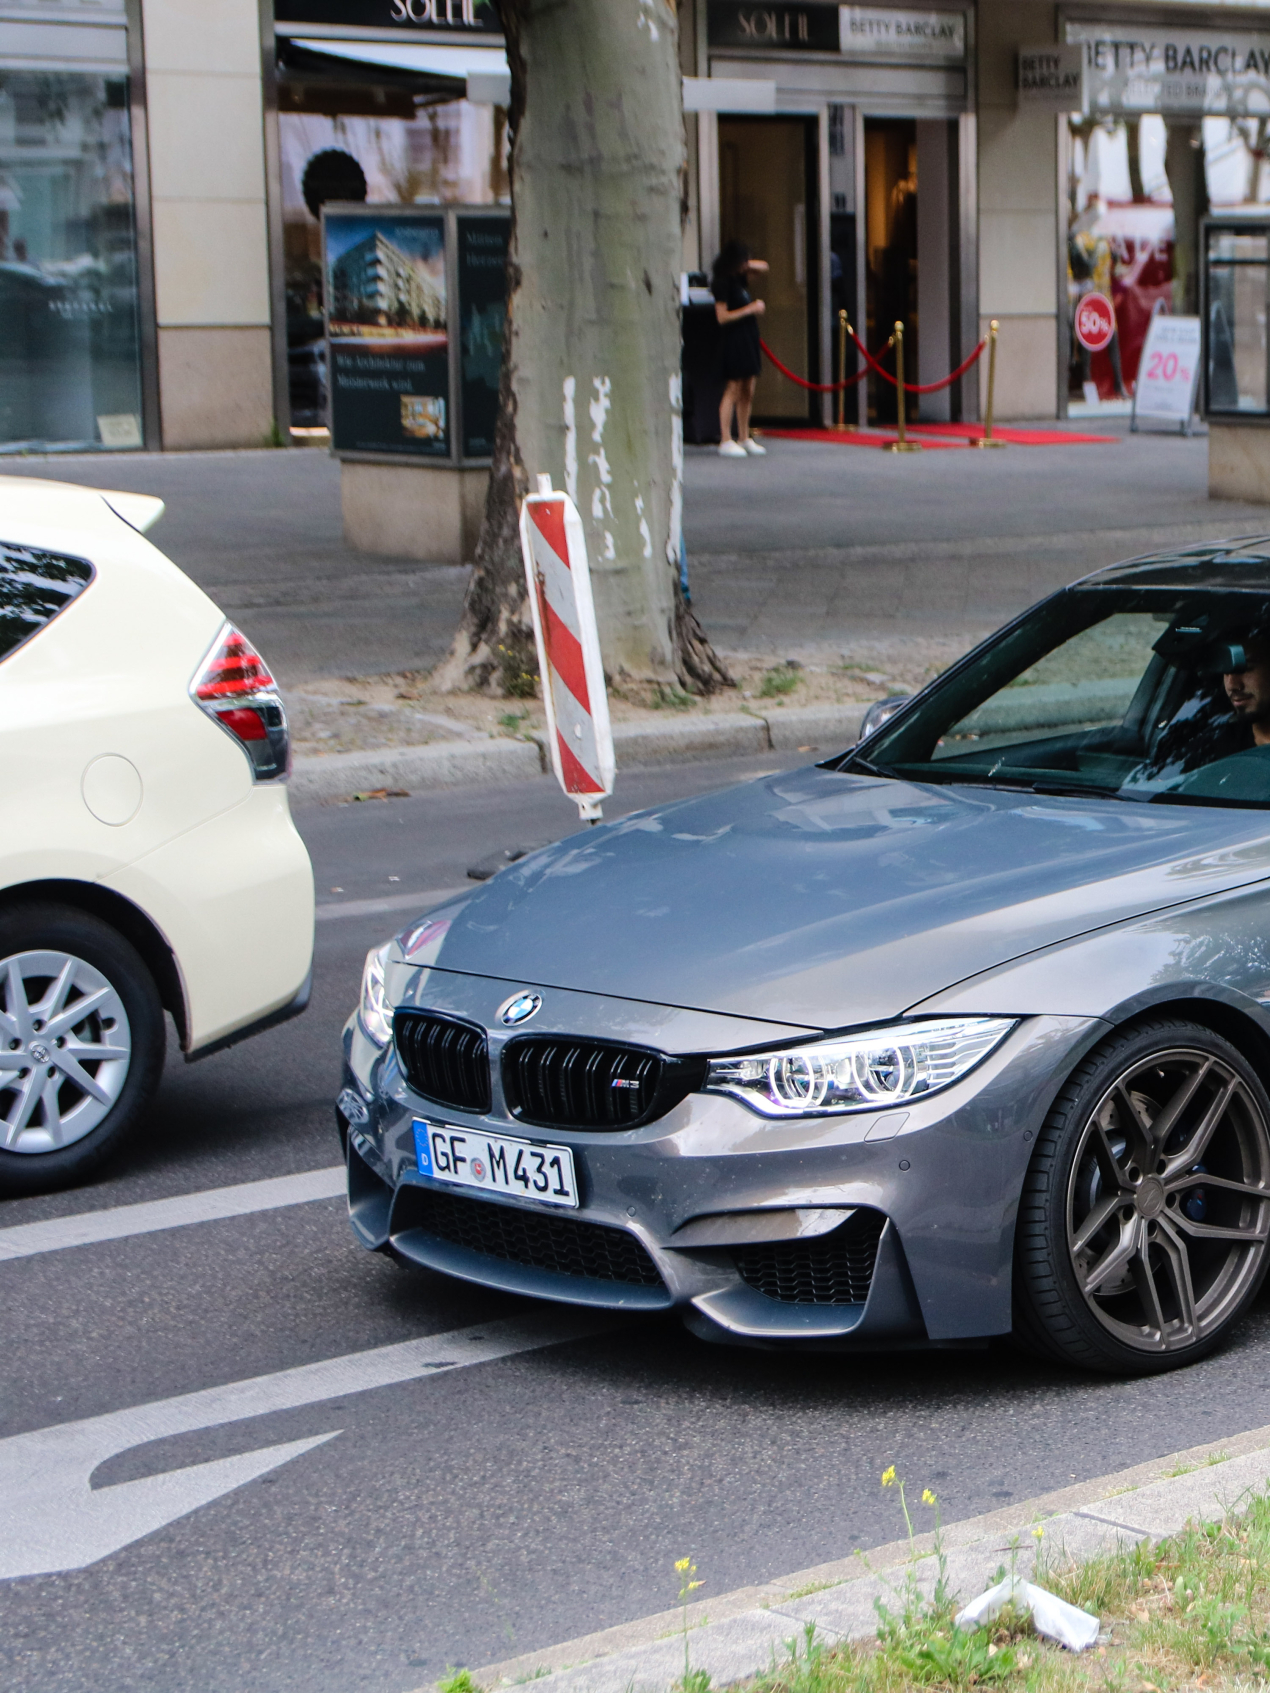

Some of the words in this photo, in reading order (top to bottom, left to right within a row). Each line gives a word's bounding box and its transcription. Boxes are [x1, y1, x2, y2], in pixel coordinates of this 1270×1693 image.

[850, 17, 892, 34] BETTY
[894, 18, 957, 38] BARCLAY
[1022, 54, 1061, 71] BETTY
[1022, 71, 1081, 89] BARCLAY
[431, 1132, 468, 1175] GF
